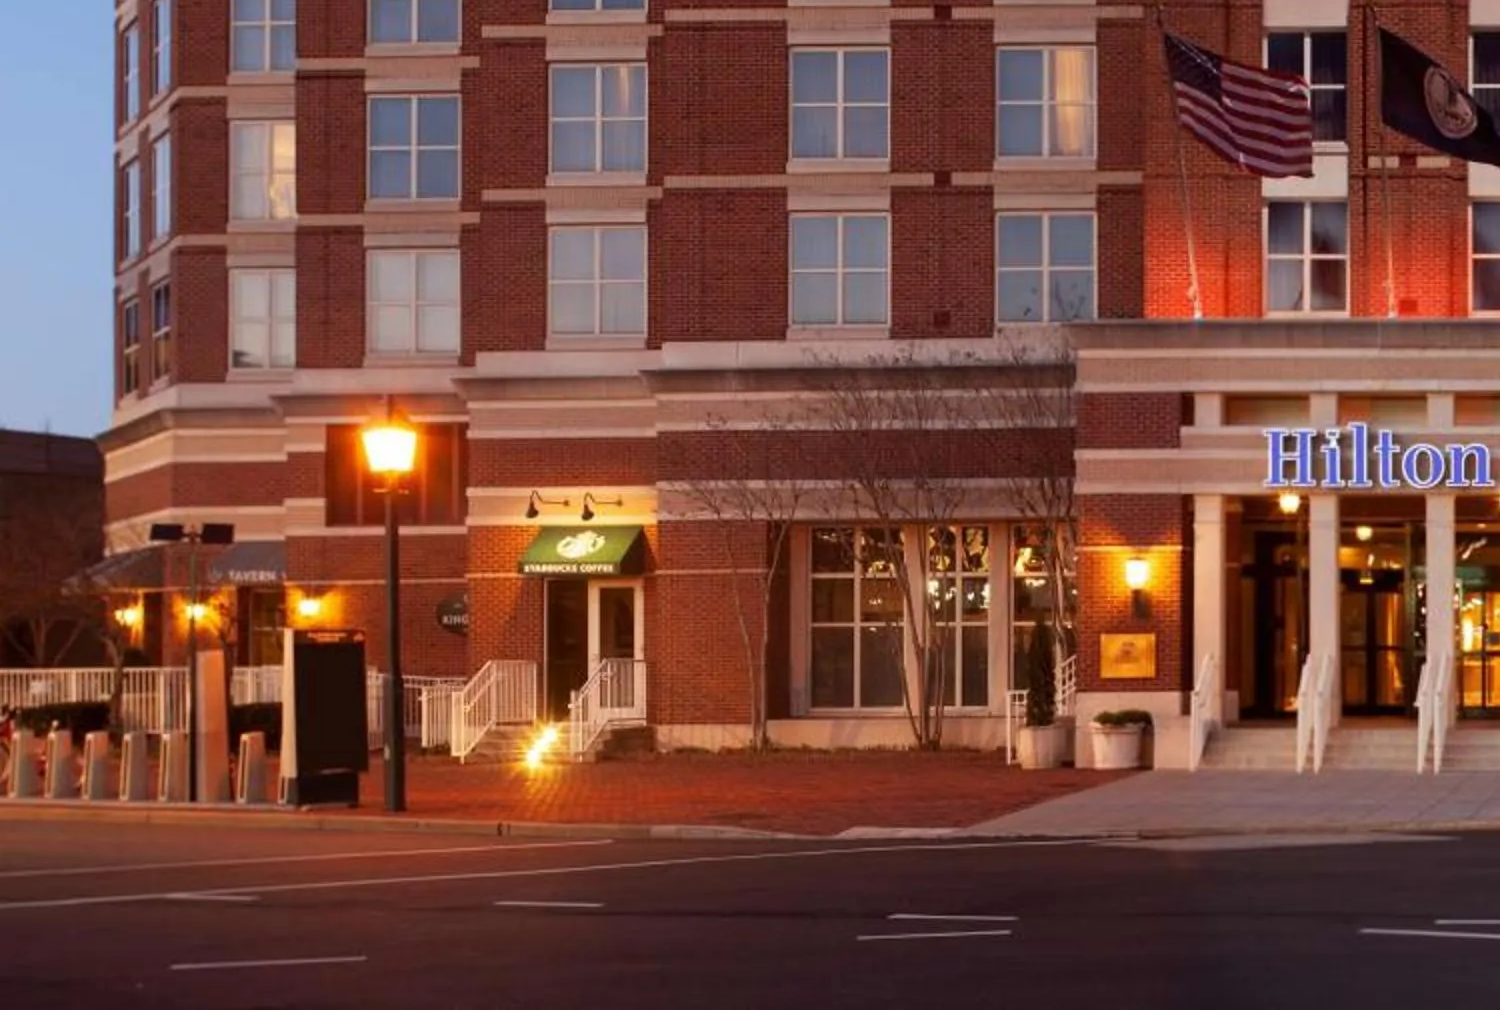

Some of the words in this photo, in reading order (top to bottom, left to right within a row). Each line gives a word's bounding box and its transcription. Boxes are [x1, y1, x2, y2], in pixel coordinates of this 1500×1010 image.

[1263, 421, 1495, 489] Hilton
[523, 562, 577, 573] STARBUCKS
[579, 562, 614, 573] COFFEE
[228, 569, 277, 582] TAVERN
